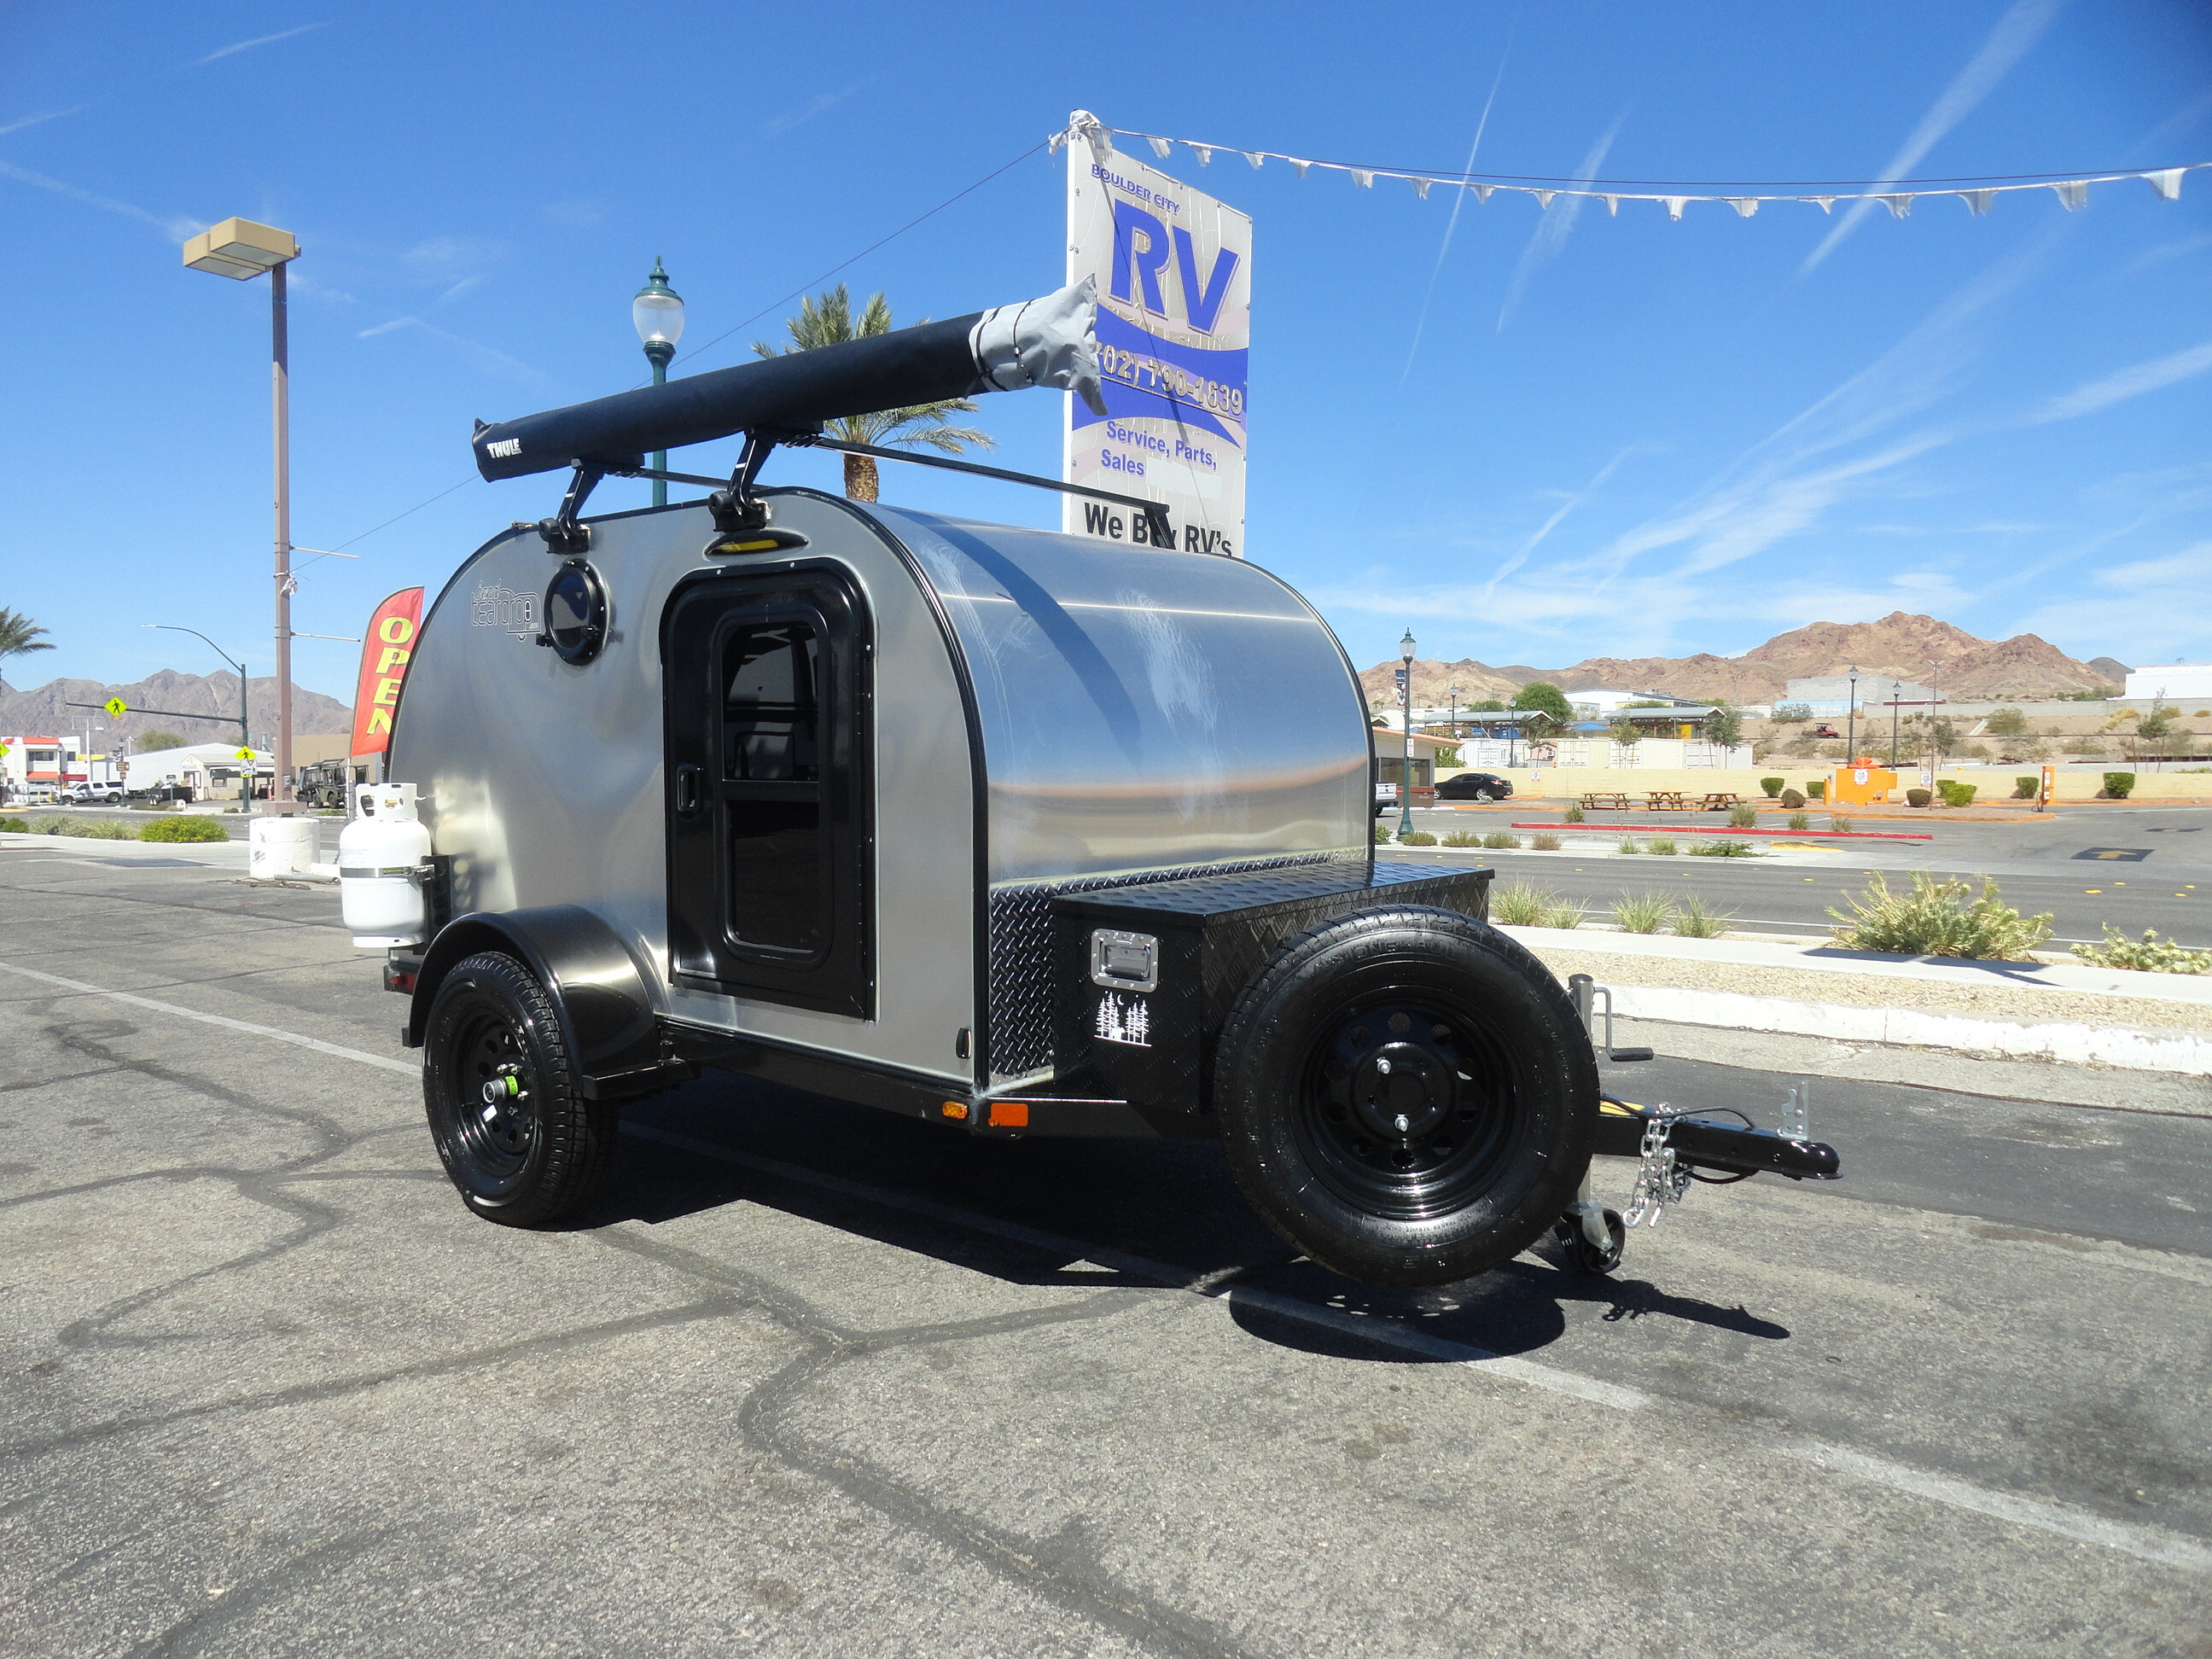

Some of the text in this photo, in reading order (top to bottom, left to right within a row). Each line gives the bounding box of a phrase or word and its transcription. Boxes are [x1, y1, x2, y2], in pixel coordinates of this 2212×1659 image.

[1091, 163, 1181, 214] BOULDER CITY
[1109, 198, 1241, 337] RV
[1146, 358, 1243, 416] 790-1639
[486, 438, 522, 459] THULE
[1100, 448, 1144, 476] Sales
[1106, 420, 1217, 471] Service, Parts,
[1084, 502, 1123, 539] We
[1185, 524, 1232, 557] RV's
[366, 616, 415, 735] OPEN
